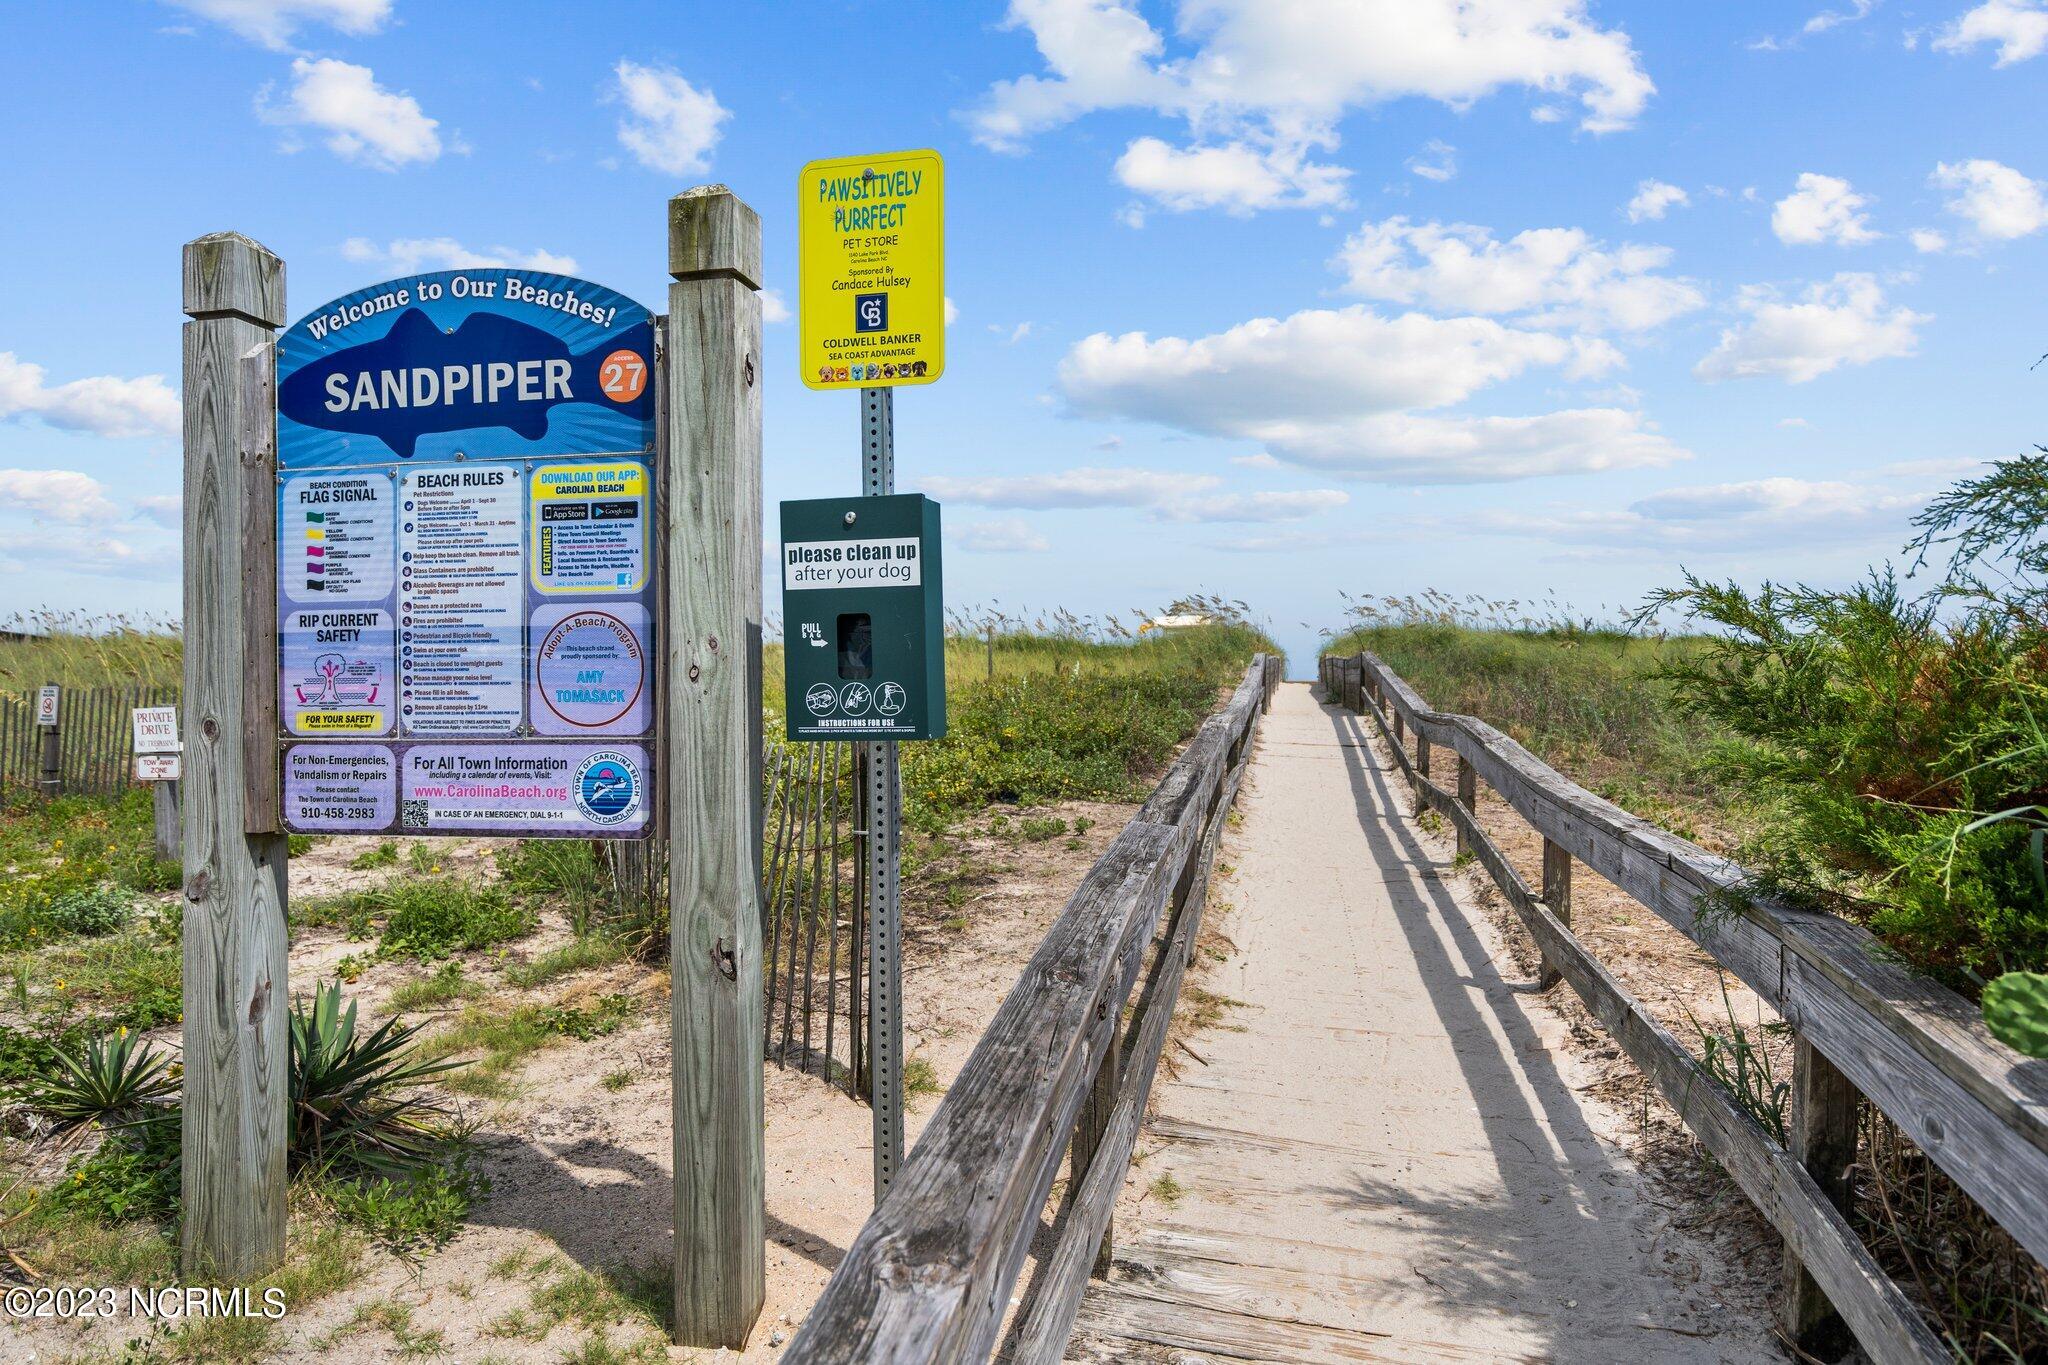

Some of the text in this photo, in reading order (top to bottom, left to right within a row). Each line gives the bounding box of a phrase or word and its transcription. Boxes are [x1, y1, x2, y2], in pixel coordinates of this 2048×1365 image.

[820, 170, 921, 202] PAWSITIVELY
[835, 204, 906, 232] PURRFECT
[844, 235, 898, 249] PET STORE
[849, 266, 894, 277] Sponsored By
[832, 276, 910, 290] Candace Hulsey
[307, 276, 616, 341] Welcome to Our Beaches!
[823, 334, 921, 349] COLDWELL BANKER
[829, 348, 915, 360] SEA COAST ADVANTAGE
[605, 364, 643, 392] 27
[324, 359, 573, 412] SANDPIPER
[418, 472, 504, 488] BEACH RULES
[541, 470, 640, 483] DOWNLOAD OUR APP:
[301, 489, 377, 503] FLAG SIGNAL
[556, 484, 624, 494] CAROLINA BEACH
[543, 528, 551, 574] FEATURES
[788, 543, 916, 565] please clean up
[795, 562, 911, 584] after your dog
[300, 613, 378, 627] RIP CURRENT
[801, 623, 821, 633] PULL
[317, 629, 360, 642] SAFETY
[544, 618, 638, 659] Adopt-A-Beach Program
[576, 670, 604, 683] AMY
[556, 690, 625, 702] TOMASACK
[137, 712, 173, 723] PRIVATE
[141, 725, 170, 735] DRIVE
[293, 755, 389, 766] For Non-Emergencies,
[414, 756, 568, 770] For All Town Information
[294, 770, 339, 779] Vandalism
[353, 770, 387, 781] Repairs
[429, 771, 460, 780] including
[575, 754, 640, 796] TOWN OF CAROLINA BEACH
[414, 784, 567, 801] www.CarolinaBeach.org
[301, 807, 375, 818] 910-458-2983
[485, 811, 529, 819] EMERGENCY,
[579, 802, 636, 823] NORTH CAROLINA
